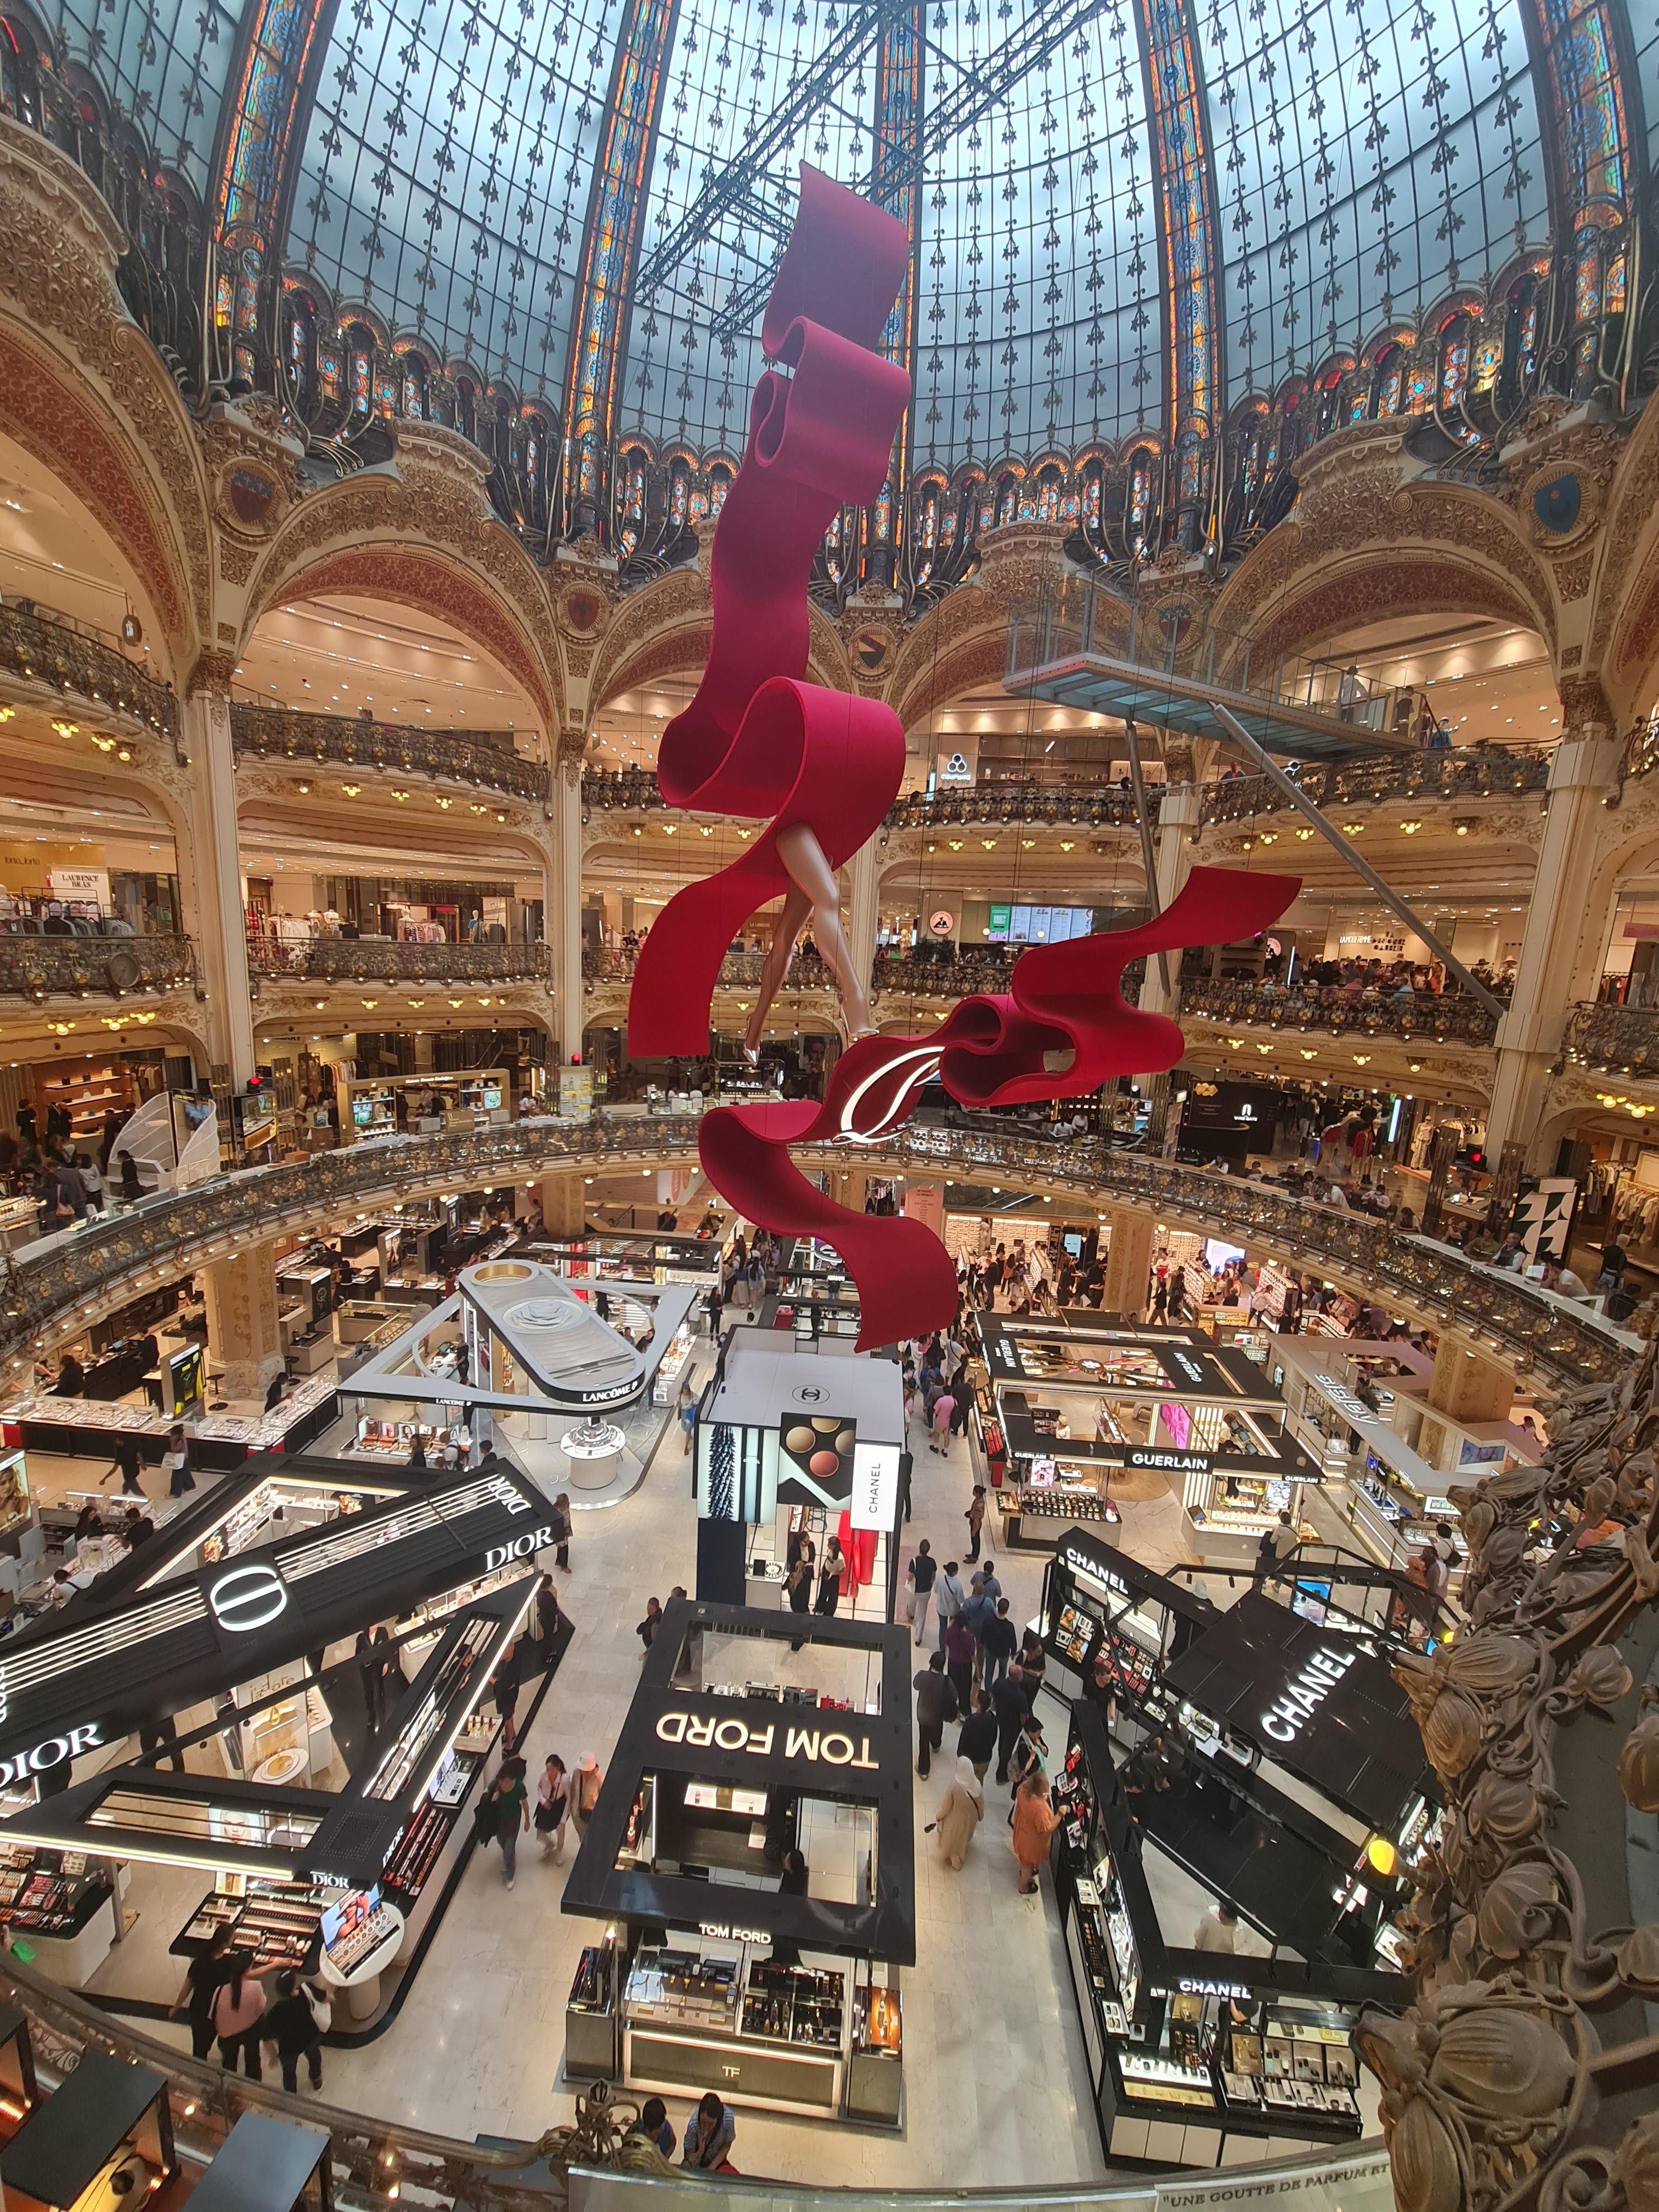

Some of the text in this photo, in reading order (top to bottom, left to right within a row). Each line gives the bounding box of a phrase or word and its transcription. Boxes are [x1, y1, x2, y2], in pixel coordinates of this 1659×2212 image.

[999, 1339, 1017, 1368] GUERLAIN
[1173, 1352, 1202, 1382] GUERLAIN
[1314, 1374, 1379, 1425] sisley
[1132, 1453, 1208, 1470] GUERLAIN
[488, 1476, 532, 1515] DIOR
[868, 1463, 881, 1513] CHANEL
[1285, 1476, 1319, 1484] GUERLAIN
[484, 1527, 554, 1572] DIOR
[1066, 1548, 1128, 1595] CHANEL
[1262, 1647, 1356, 1742] CHANEL
[656, 1713, 879, 1769] TOM FORD
[382, 1826, 404, 1869] DIOR
[312, 1874, 349, 1889] DIOR
[698, 1924, 771, 1944] TOM FORD
[1180, 1981, 1251, 1999] CHANEL
[721, 2066, 741, 2078] TF
[1210, 2183, 1275, 2202] GOUTTE
[1279, 2179, 1301, 2192] DE
[1305, 2168, 1367, 2188] PARFUM
